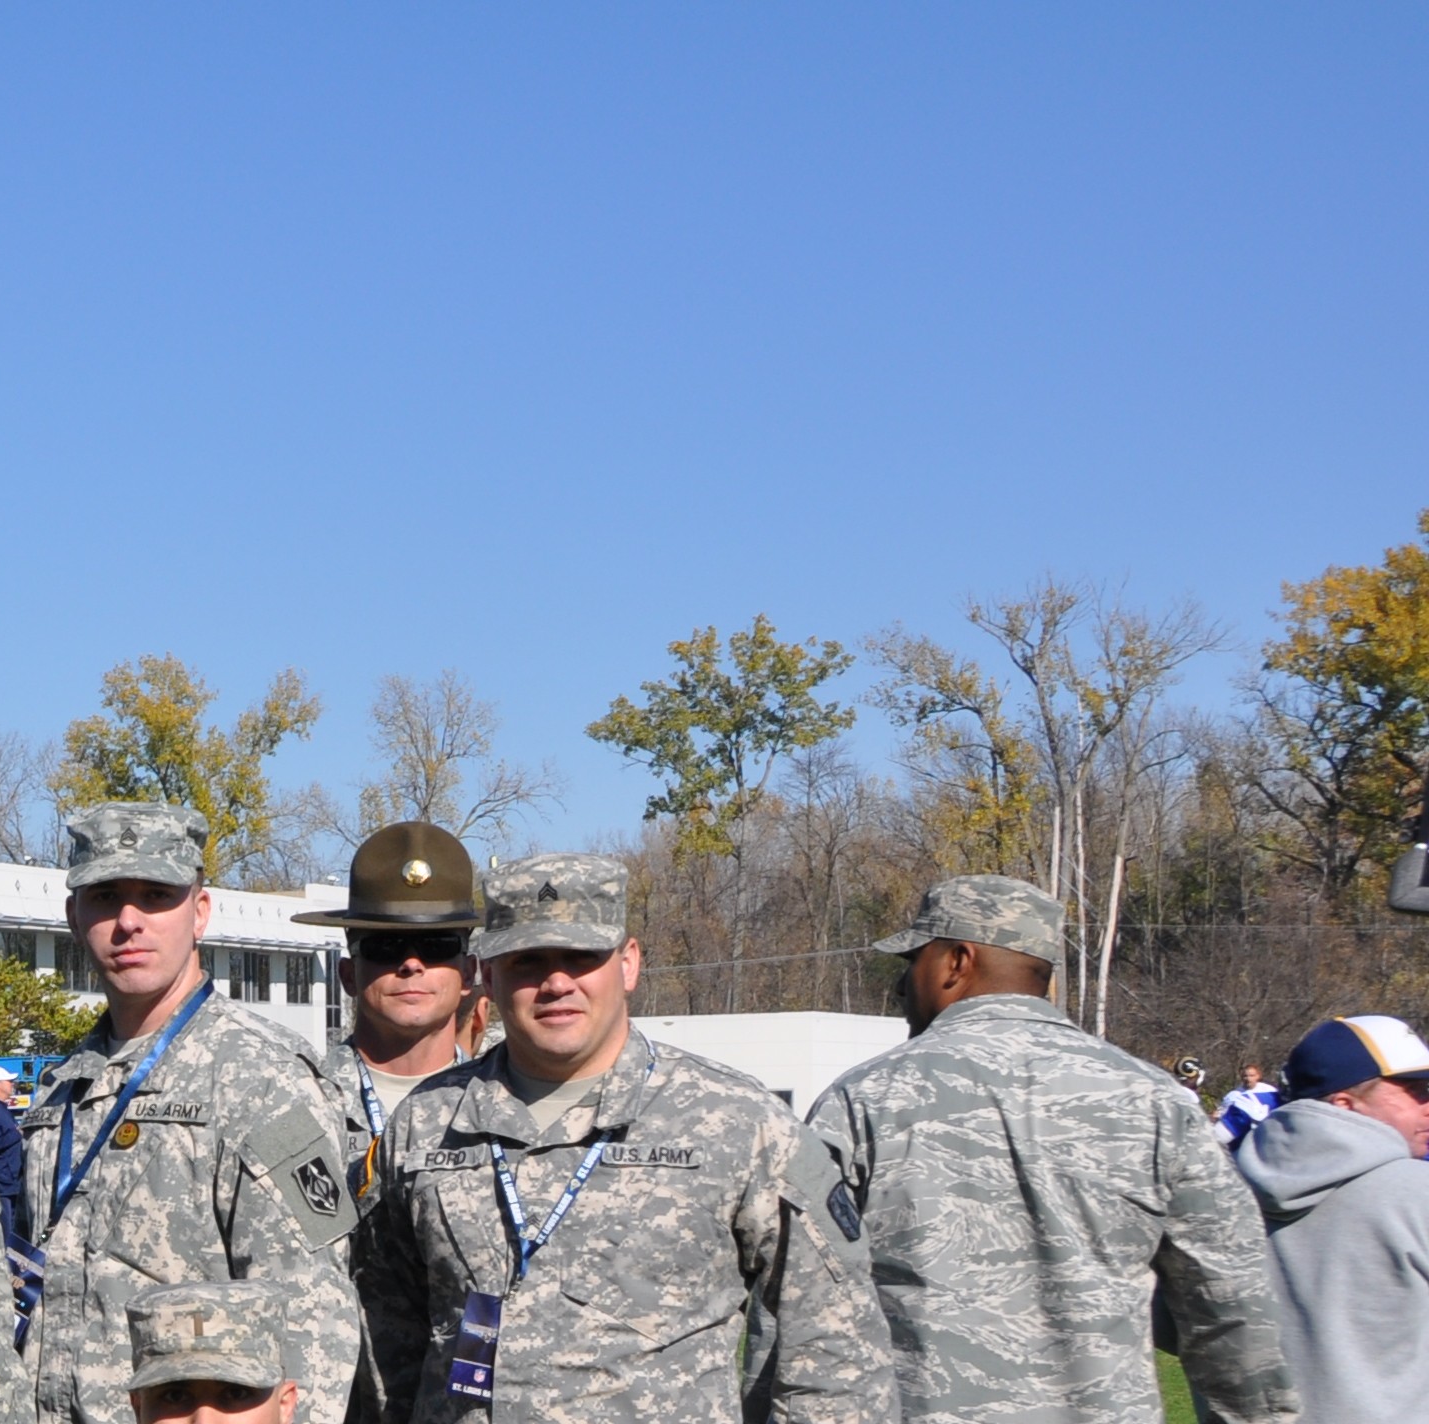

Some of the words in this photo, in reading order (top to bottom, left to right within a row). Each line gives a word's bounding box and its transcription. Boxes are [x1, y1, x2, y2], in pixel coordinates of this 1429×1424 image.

[135, 1104, 158, 1118] U.S.
[162, 1104, 203, 1118] ARMY
[424, 1150, 467, 1167] FORD
[612, 1148, 641, 1162] U.S.
[647, 1148, 694, 1164] ARMY
